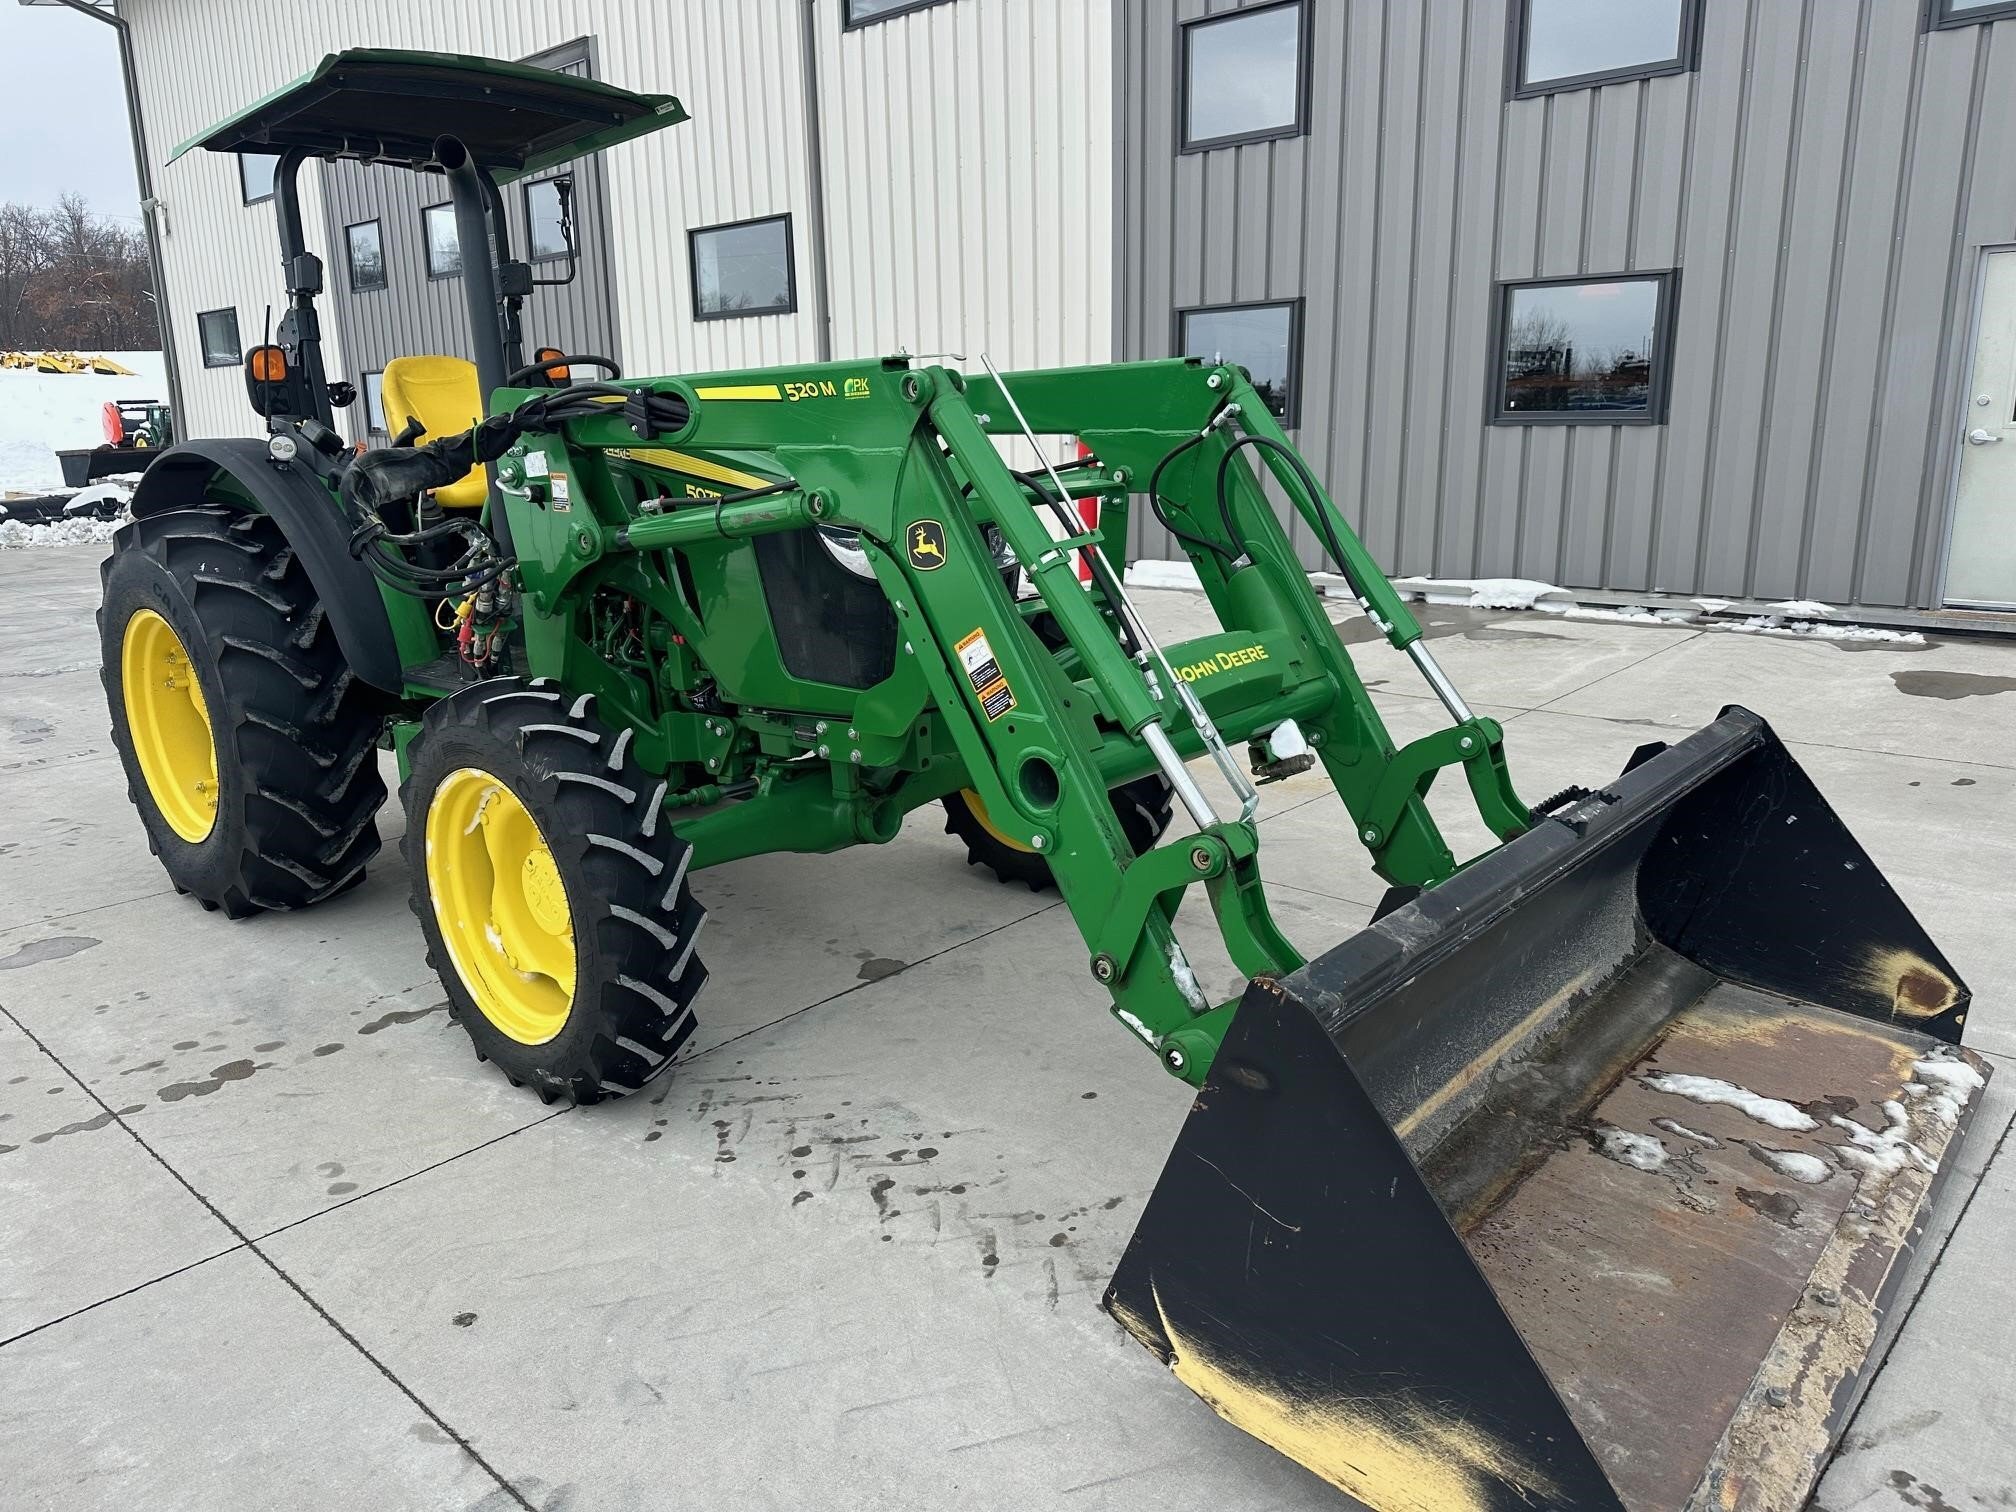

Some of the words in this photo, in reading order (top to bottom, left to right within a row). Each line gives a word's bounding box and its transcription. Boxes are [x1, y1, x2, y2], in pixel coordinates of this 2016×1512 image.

[784, 382, 819, 402] 520
[818, 381, 837, 396] M
[1173, 659, 1220, 682] JOHN
[1215, 645, 1270, 670] DEERE
